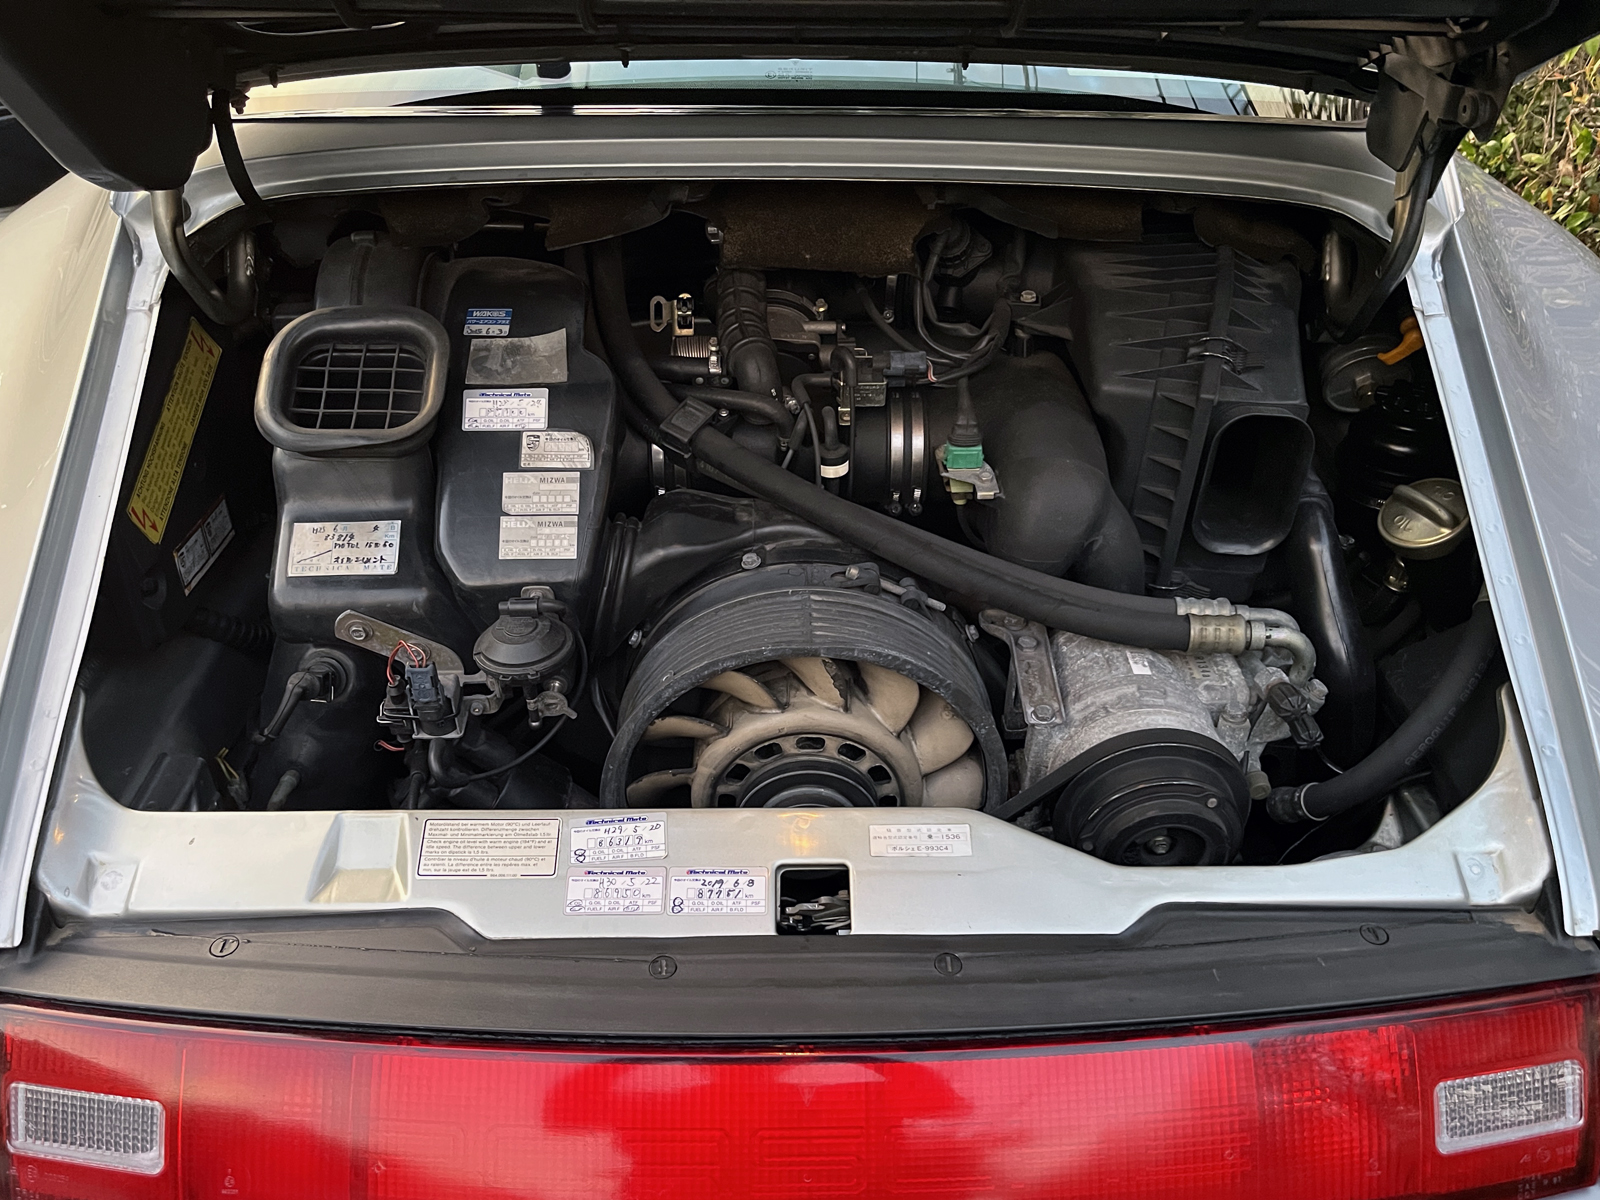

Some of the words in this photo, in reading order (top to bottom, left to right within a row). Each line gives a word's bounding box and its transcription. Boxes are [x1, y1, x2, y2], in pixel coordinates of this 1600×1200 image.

[503, 519, 535, 528] HELIX
[1403, 705, 1459, 766] AEROQUIP
[701, 879, 724, 888] 2019
[733, 879, 740, 887] 6
[747, 879, 754, 887] 8
[593, 888, 640, 898] 86950
